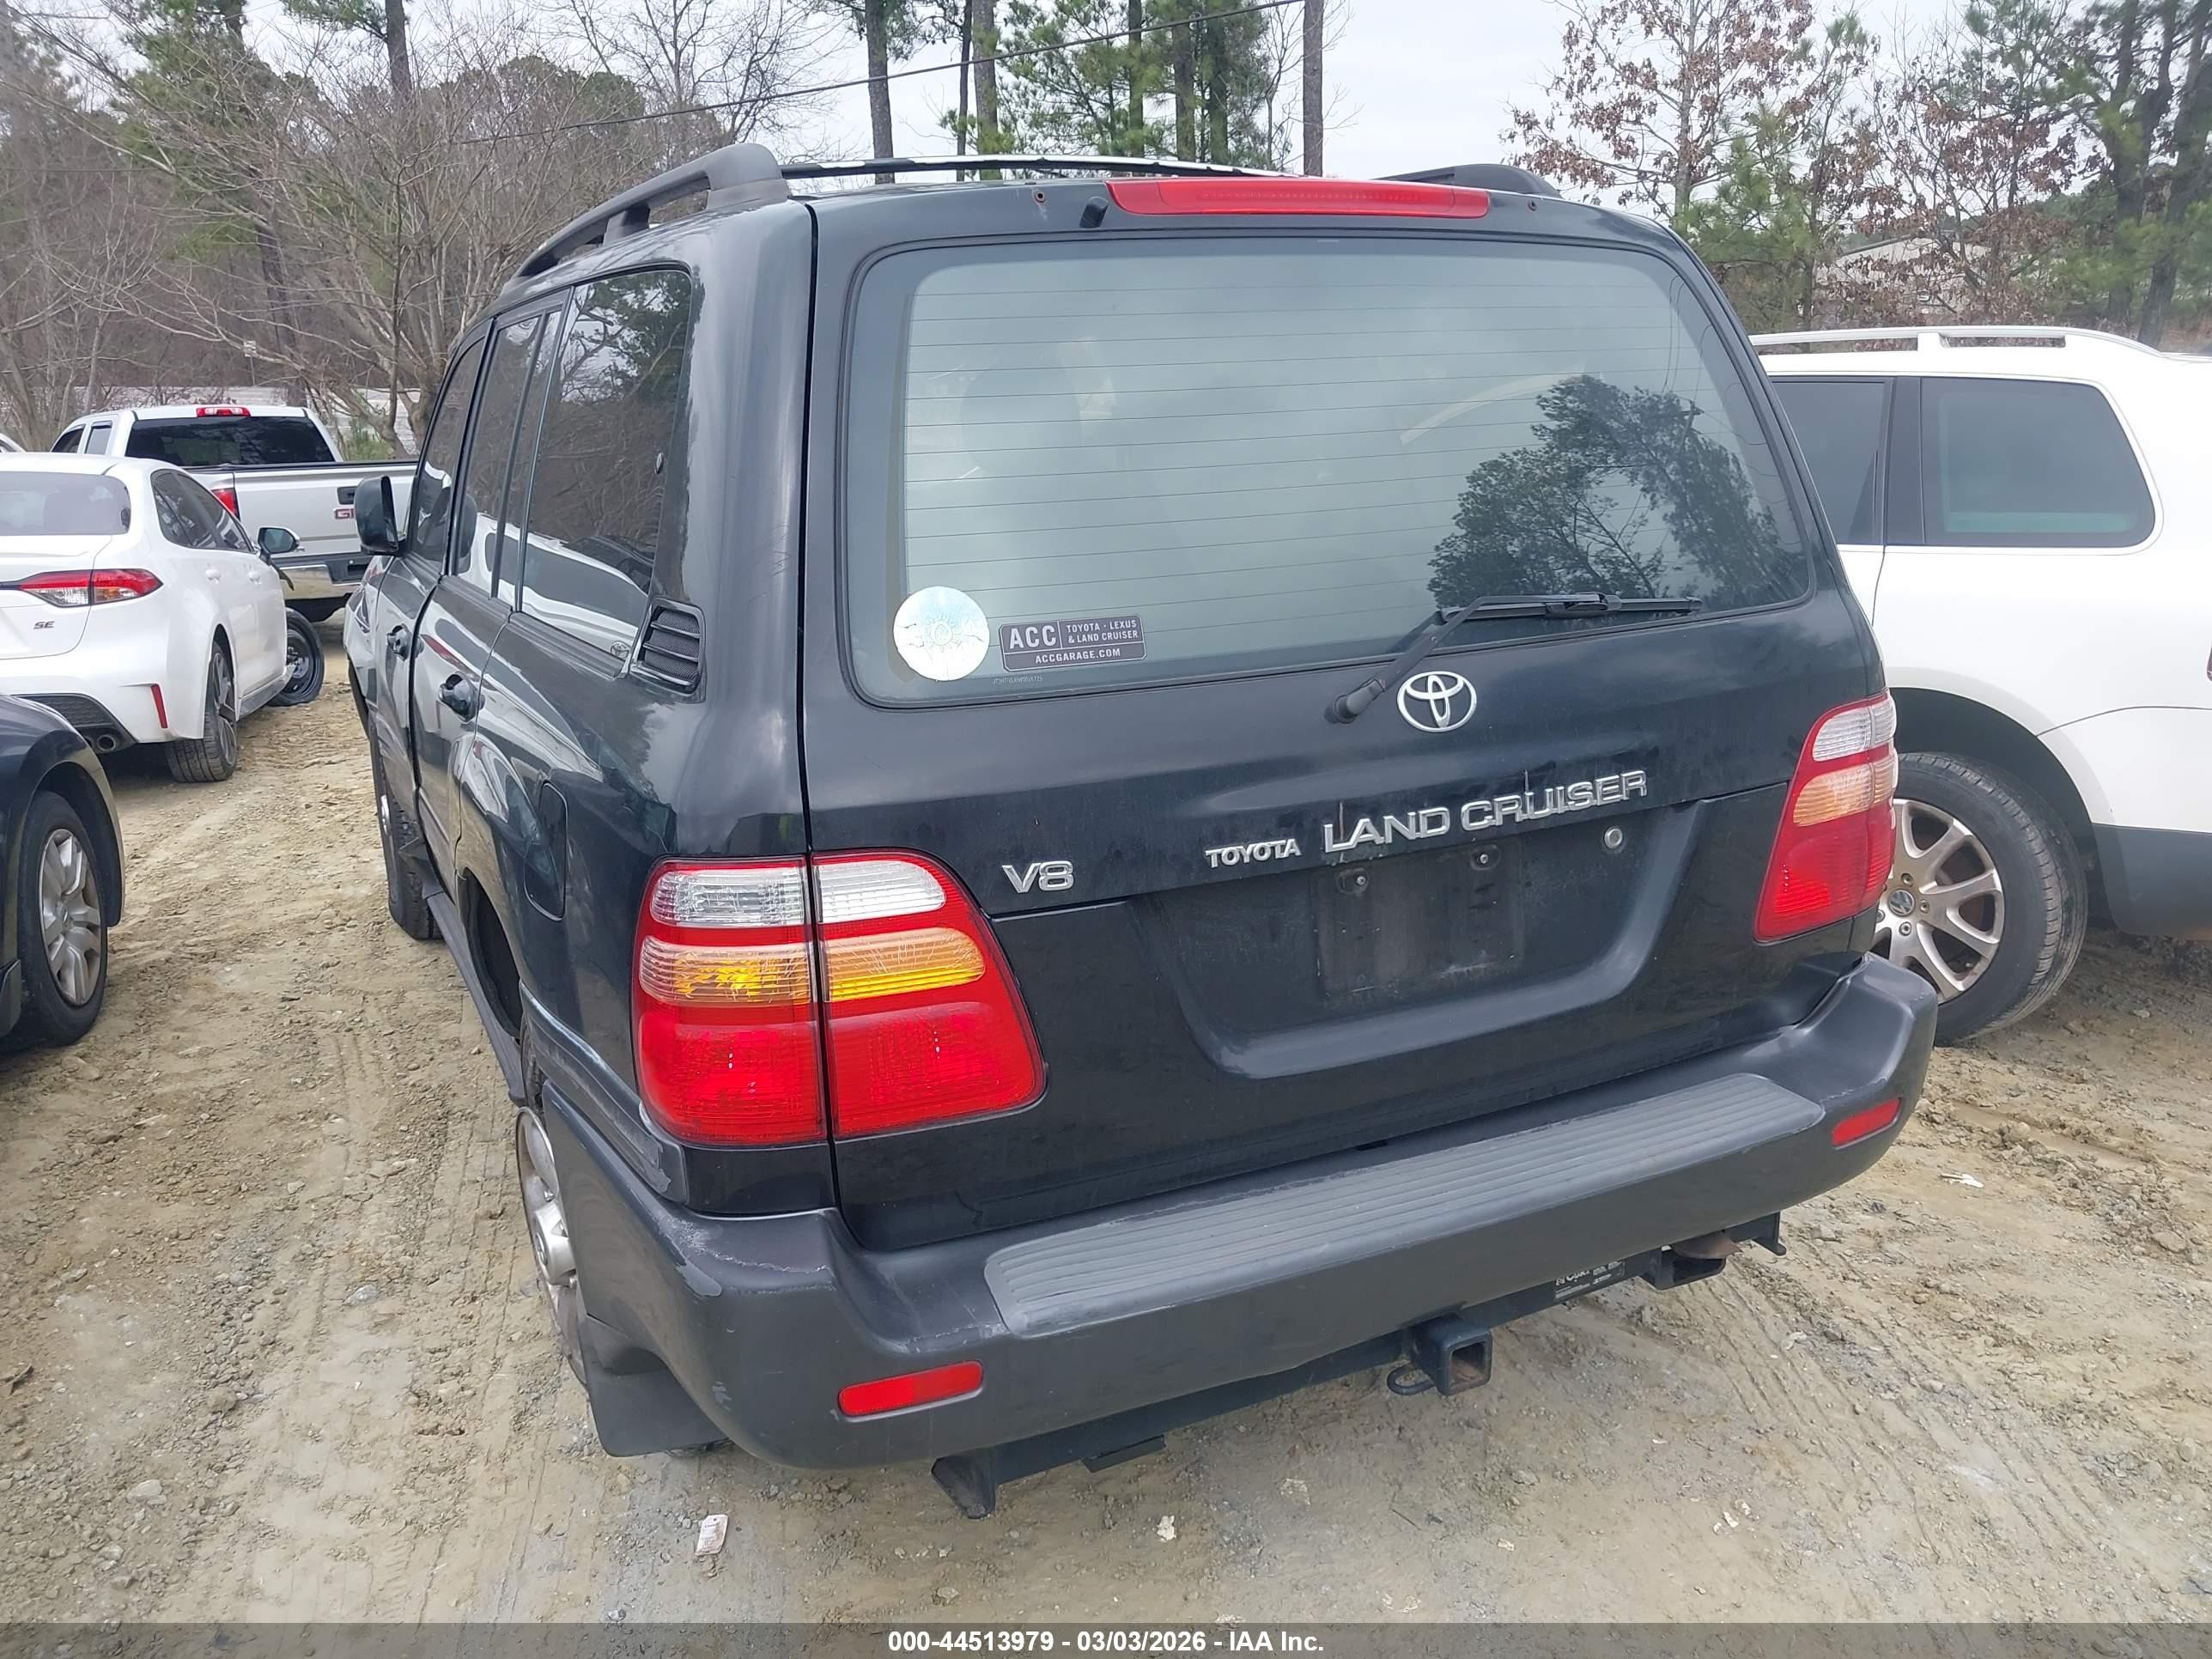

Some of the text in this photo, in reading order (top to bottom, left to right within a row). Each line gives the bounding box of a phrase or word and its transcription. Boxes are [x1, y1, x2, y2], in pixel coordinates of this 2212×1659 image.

[33, 620, 56, 630] SE
[1066, 623, 1101, 633] TOYOTA
[1109, 619, 1137, 630] LEXUS
[1009, 624, 1057, 649] ACC
[1067, 629, 1139, 644] & LAND CRUISER
[1035, 647, 1121, 664] ACCGARAGE.COM
[1204, 769, 1648, 869] TOYOTA LAND CRUISER
[1001, 860, 1074, 894] V8
